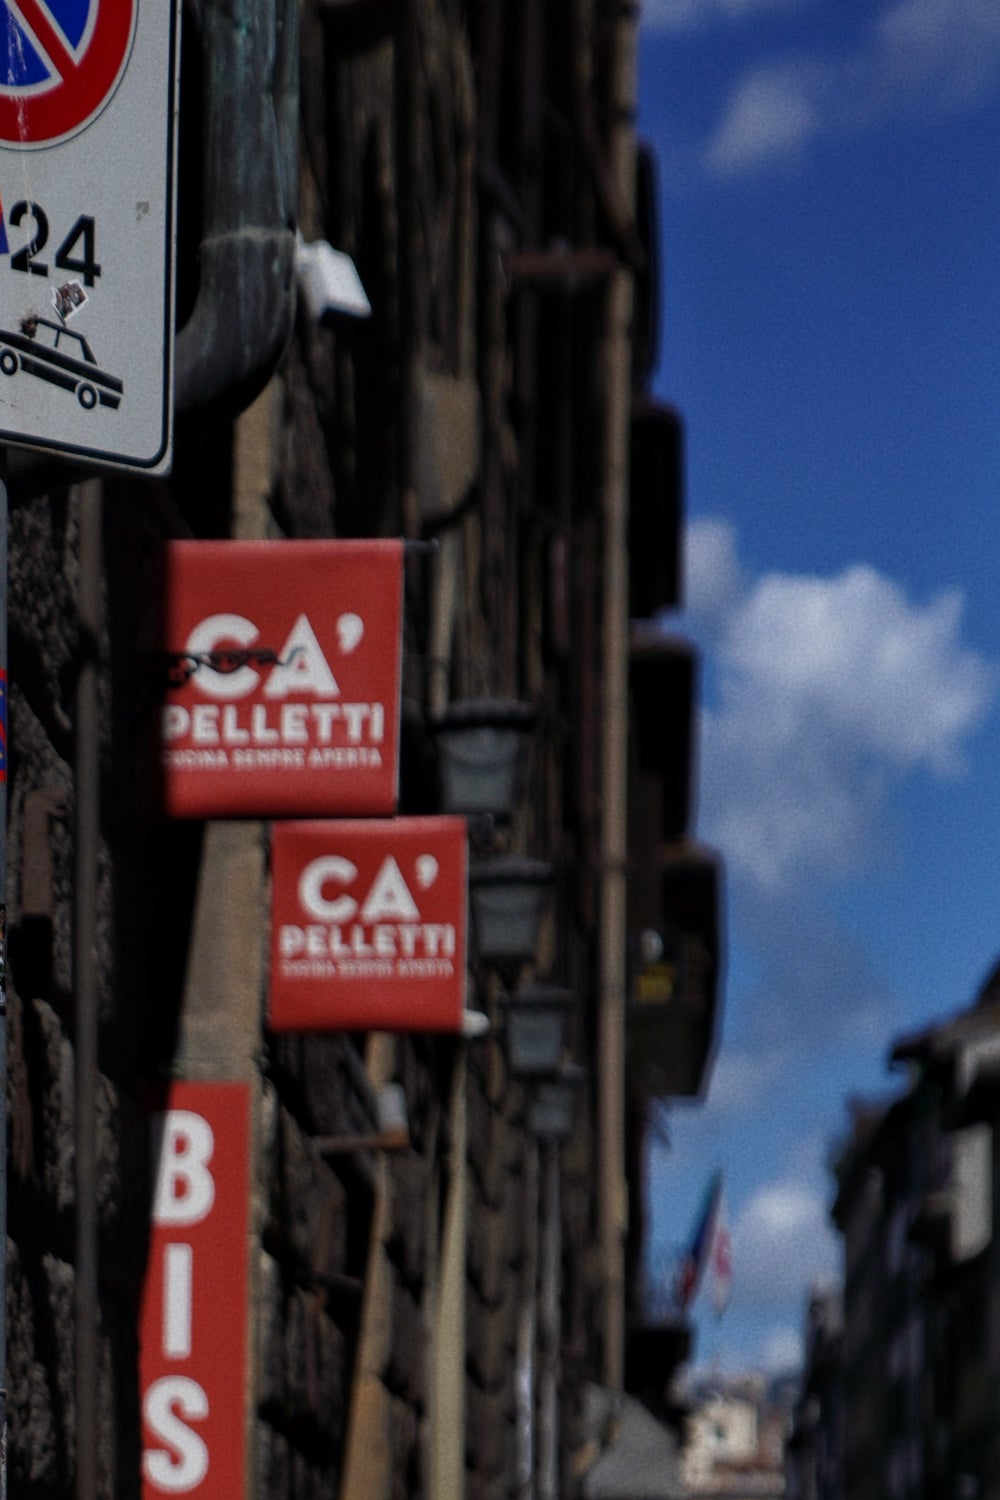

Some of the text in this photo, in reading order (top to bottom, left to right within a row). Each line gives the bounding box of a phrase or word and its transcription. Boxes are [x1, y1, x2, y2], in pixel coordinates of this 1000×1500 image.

[161, 703, 385, 746] PELLETTI
[298, 854, 439, 923] CA'
[279, 924, 456, 958] PELLETTI
